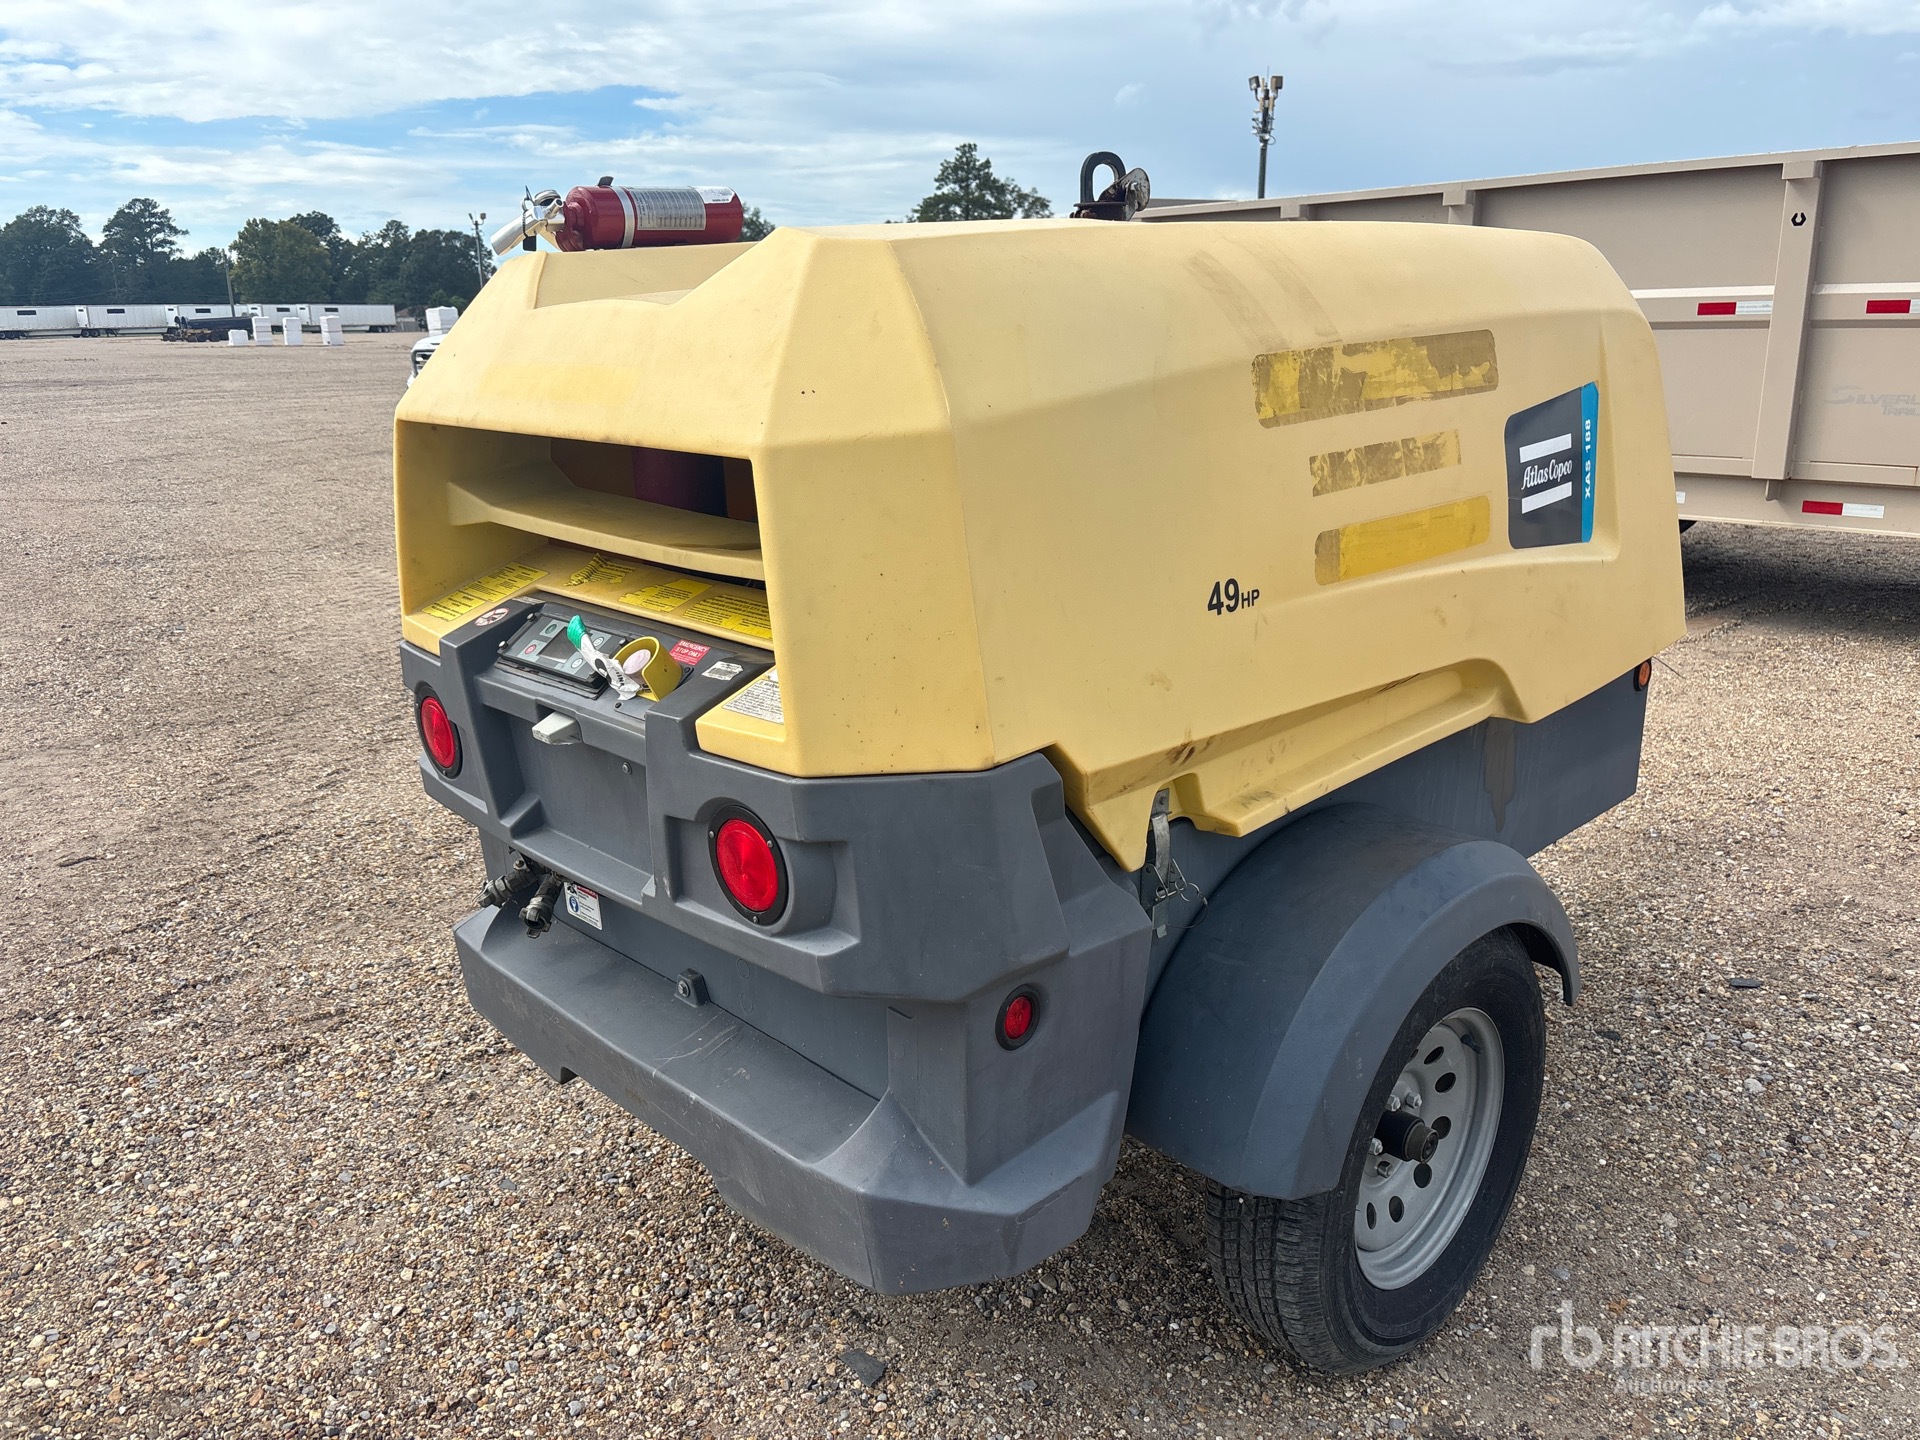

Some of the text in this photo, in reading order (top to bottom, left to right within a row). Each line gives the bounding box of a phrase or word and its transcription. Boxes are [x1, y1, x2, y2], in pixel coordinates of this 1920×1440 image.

[675, 647, 702, 658] STOP ONLY
[679, 641, 708, 653] EMERGENCY
